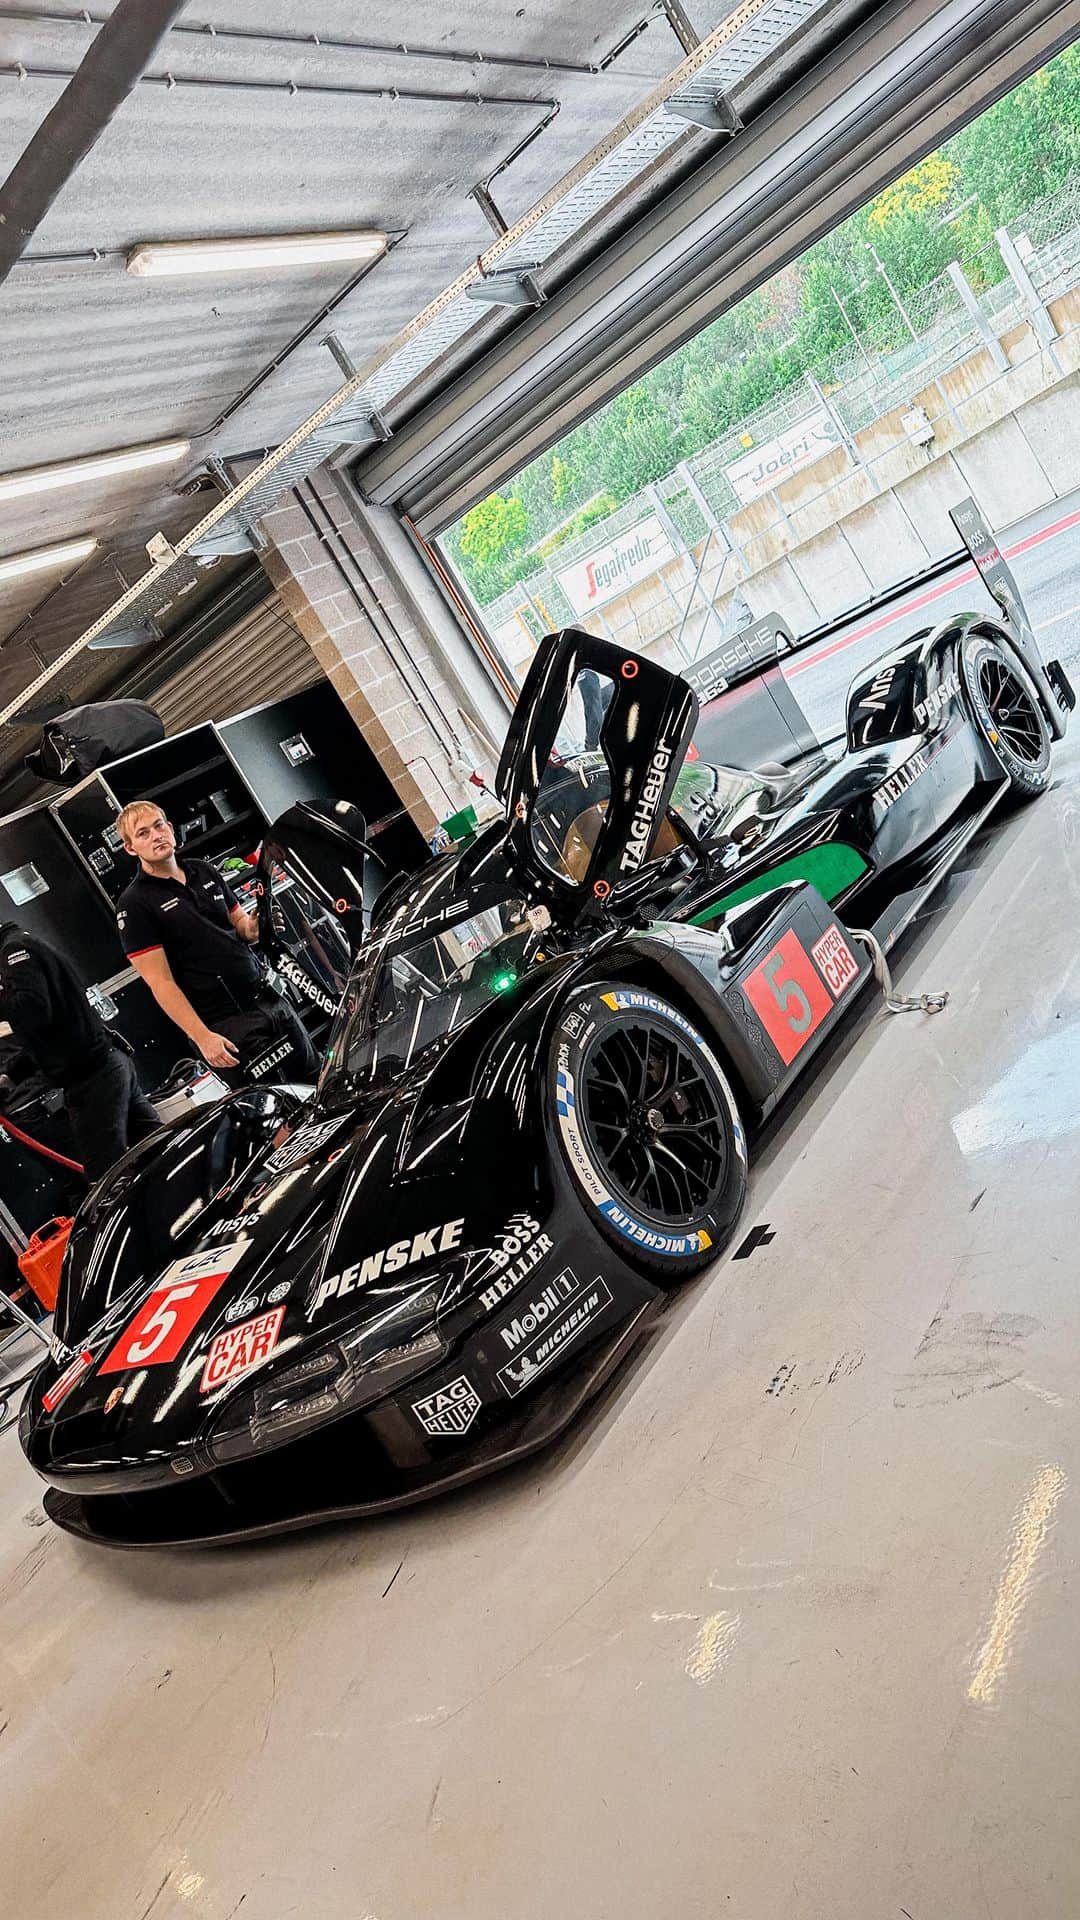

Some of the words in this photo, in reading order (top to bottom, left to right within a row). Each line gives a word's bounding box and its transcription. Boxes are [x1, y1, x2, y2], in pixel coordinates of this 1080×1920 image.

[752, 438, 809, 484] Joeri
[585, 535, 652, 599] Segafredo
[688, 626, 773, 688] PORSCHE
[913, 671, 962, 725] PENSKE
[872, 752, 930, 811] HELLER
[814, 930, 842, 968] HYPER
[824, 947, 856, 990] CAR
[761, 952, 813, 1034] 5
[630, 994, 698, 1040] MICHELIN
[251, 1041, 294, 1079] HELLER
[567, 1127, 585, 1164] SPORT
[582, 1166, 601, 1196] PILOT
[202, 1211, 261, 1240] Ansys
[489, 1214, 541, 1269] BOSS
[607, 1206, 686, 1253] MICHELIN
[316, 1217, 465, 1309] PENSKE
[478, 1232, 555, 1311] HELLER
[126, 1283, 200, 1364] 5
[226, 1298, 256, 1320] FIA
[500, 1286, 561, 1350] Mobil
[559, 1275, 573, 1293] 1
[536, 1292, 600, 1362] MICHELIN
[207, 1331, 273, 1382] CAR
[216, 1314, 278, 1353] HYPER
[418, 1381, 468, 1417] TAG
[426, 1399, 478, 1432] HEUER
